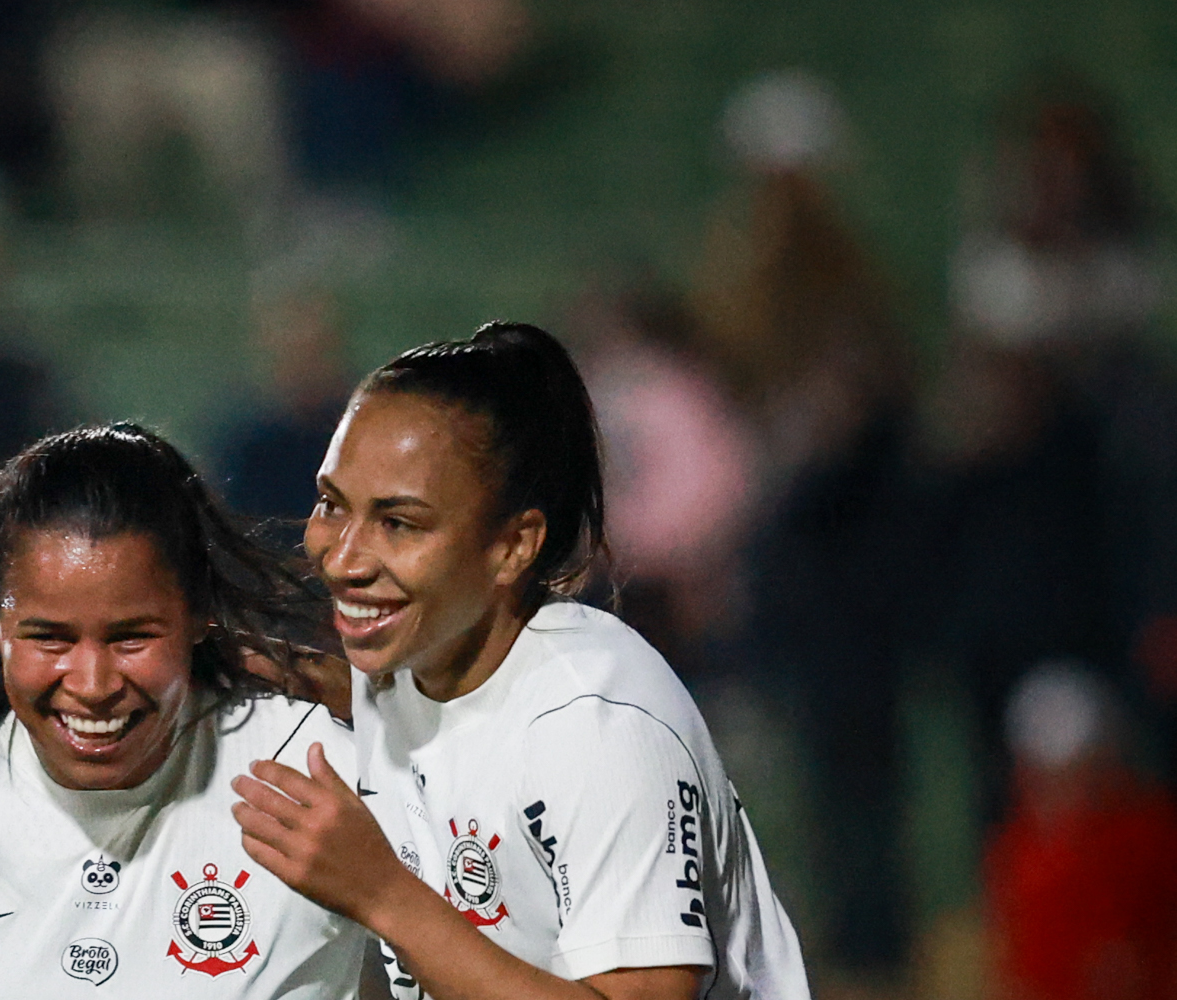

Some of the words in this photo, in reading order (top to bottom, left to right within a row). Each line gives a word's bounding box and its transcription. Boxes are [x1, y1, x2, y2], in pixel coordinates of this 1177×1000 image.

[666, 800, 676, 854] banco
[675, 779, 701, 891] bmg
[181, 887, 231, 919] CORINTHIANS
[228, 896, 244, 936] PAULISTA
[69, 944, 110, 959] Broto
[203, 941, 223, 951] 1910
